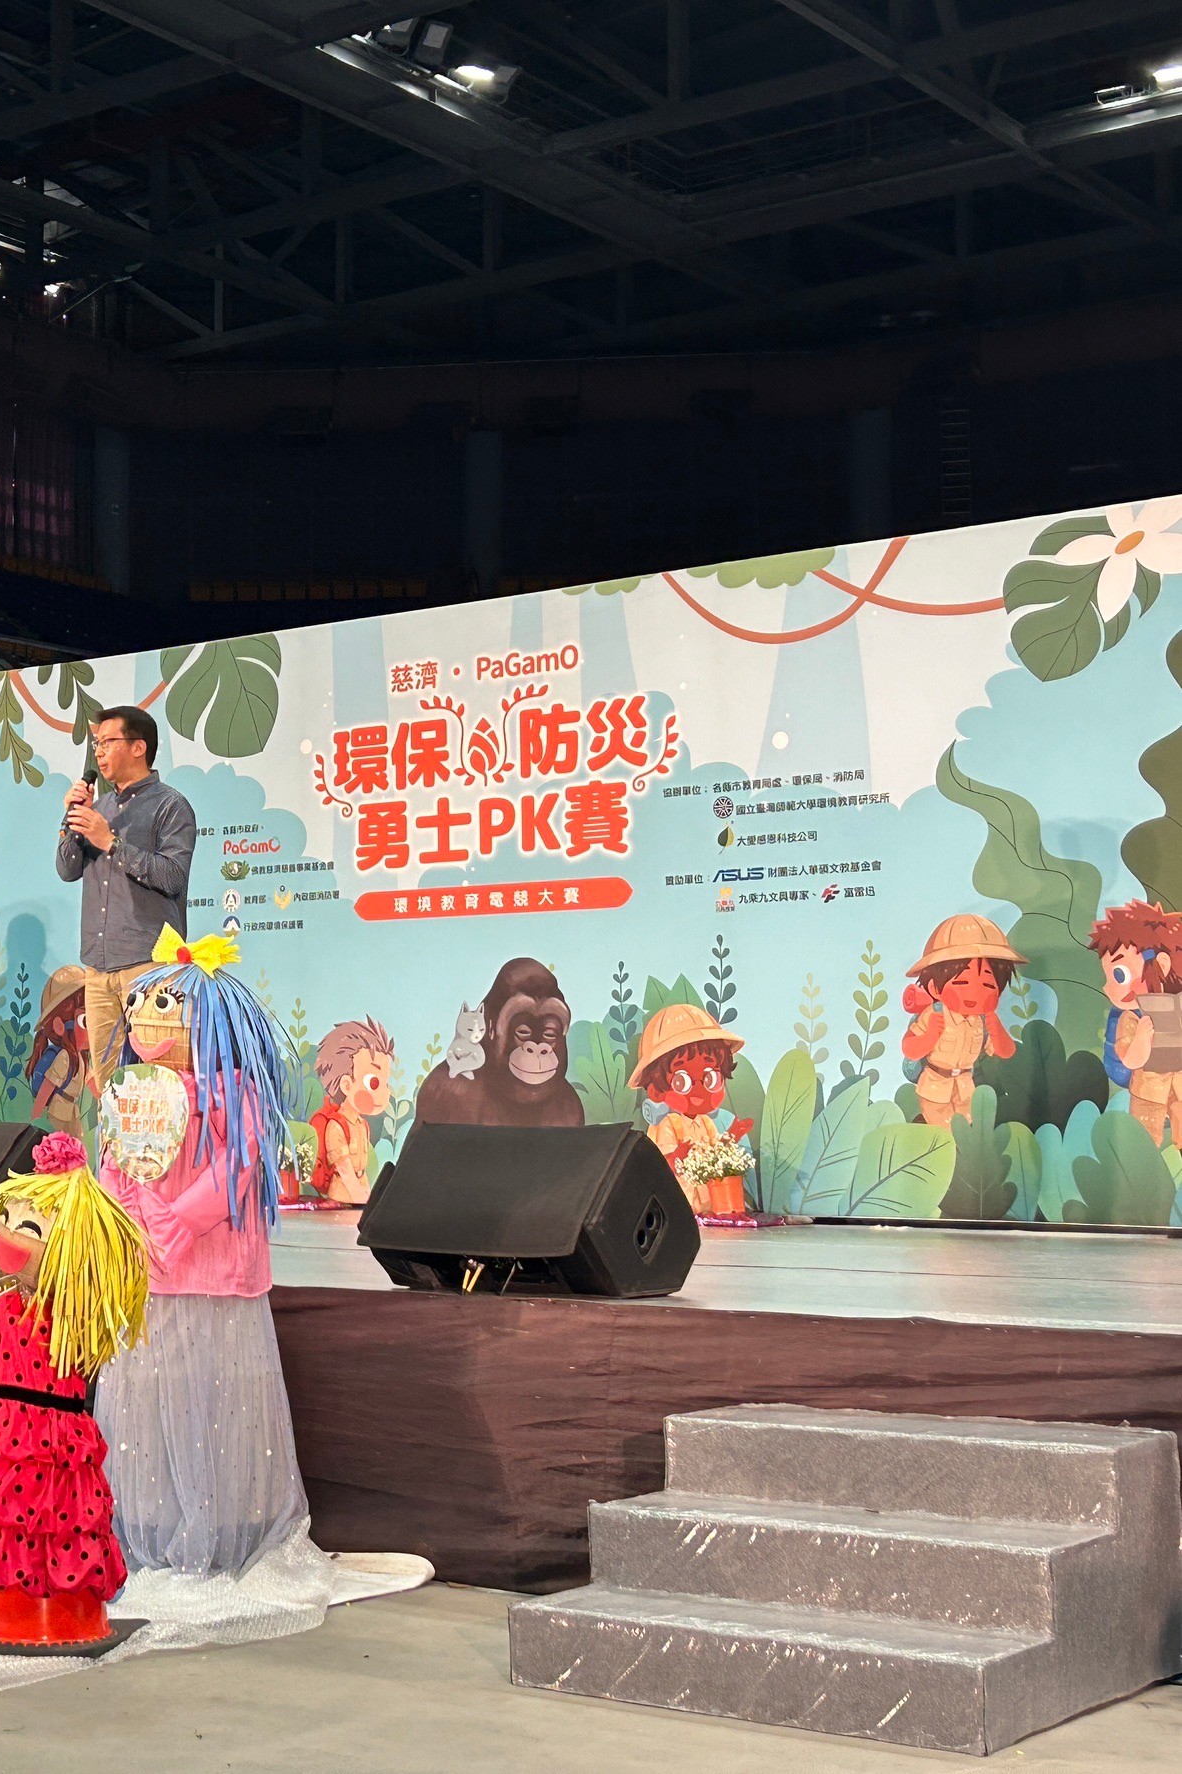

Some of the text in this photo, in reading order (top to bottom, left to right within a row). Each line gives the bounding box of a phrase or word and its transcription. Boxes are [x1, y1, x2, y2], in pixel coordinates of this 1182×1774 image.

[391, 660, 438, 692] 慈濟
[476, 645, 579, 680] PaGamO
[333, 696, 648, 794] 環保 防災
[355, 780, 630, 871] 勇士PK賽
[223, 836, 281, 855] PaGamO
[712, 867, 765, 882] ASUS
[767, 860, 882, 878] 財團法人華碩文教基金會
[393, 888, 581, 913] 環境教育電競大賽
